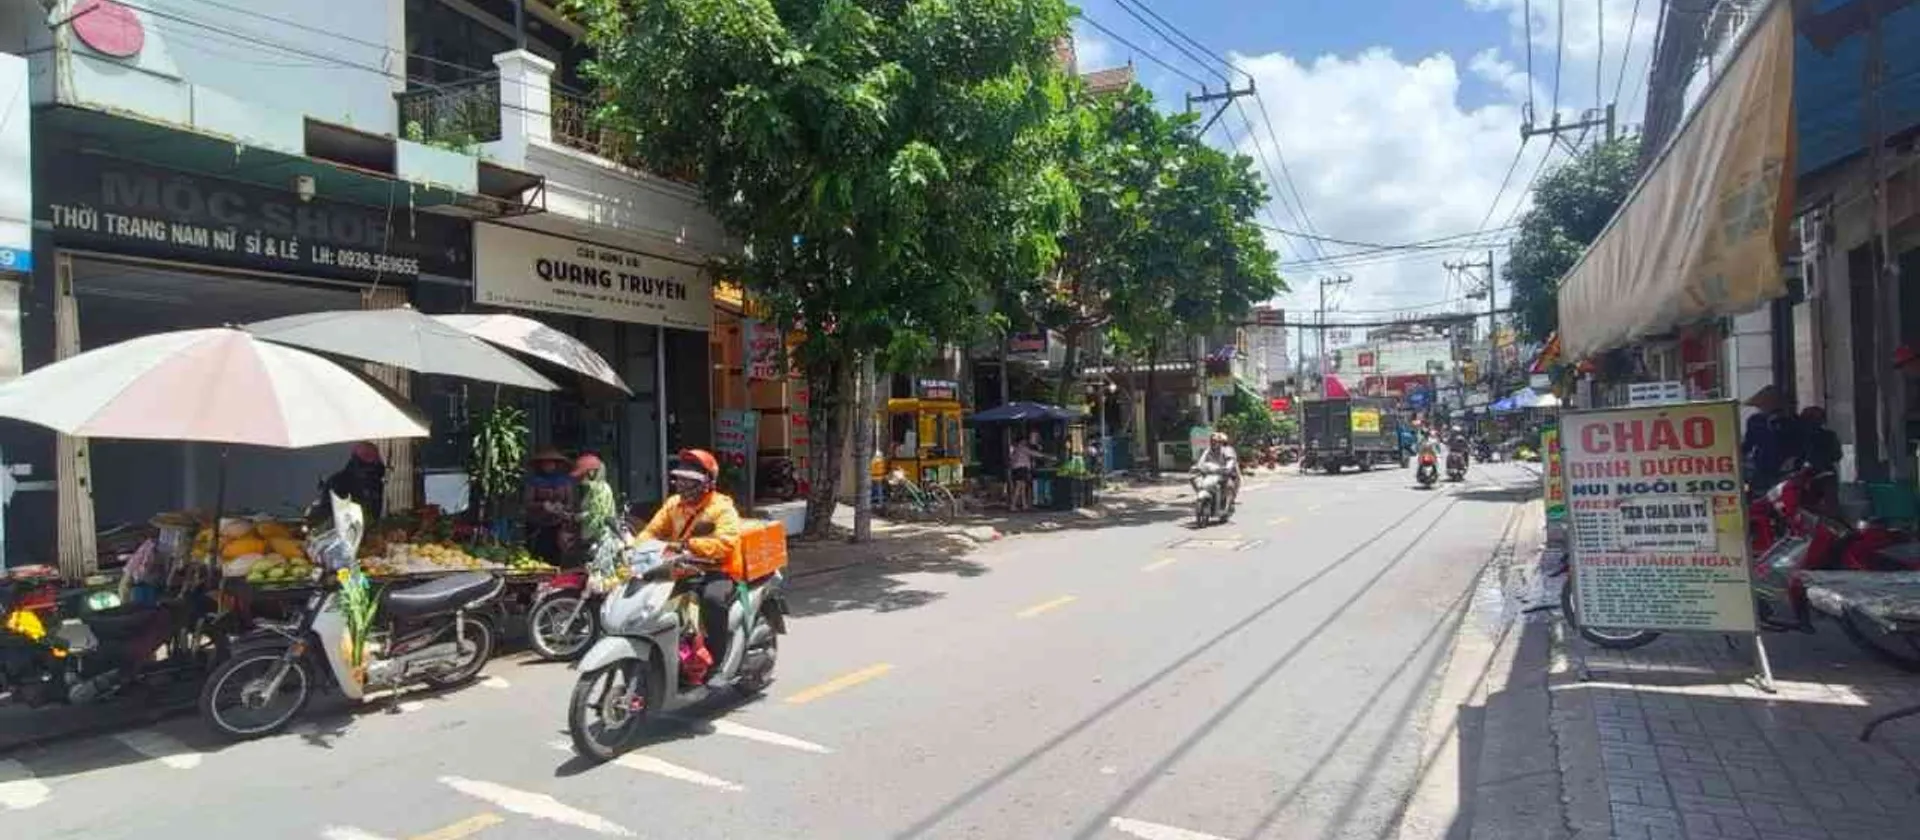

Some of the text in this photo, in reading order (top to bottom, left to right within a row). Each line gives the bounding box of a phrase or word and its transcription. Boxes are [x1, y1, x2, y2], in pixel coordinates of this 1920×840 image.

[50, 203, 98, 231] THỜI
[104, 213, 167, 242] TRANG
[171, 224, 209, 248] NAM
[213, 226, 238, 251] NỮ
[264, 236, 279, 257] &
[536, 258, 612, 289] QUANG
[1570, 459, 1631, 479] DINH
